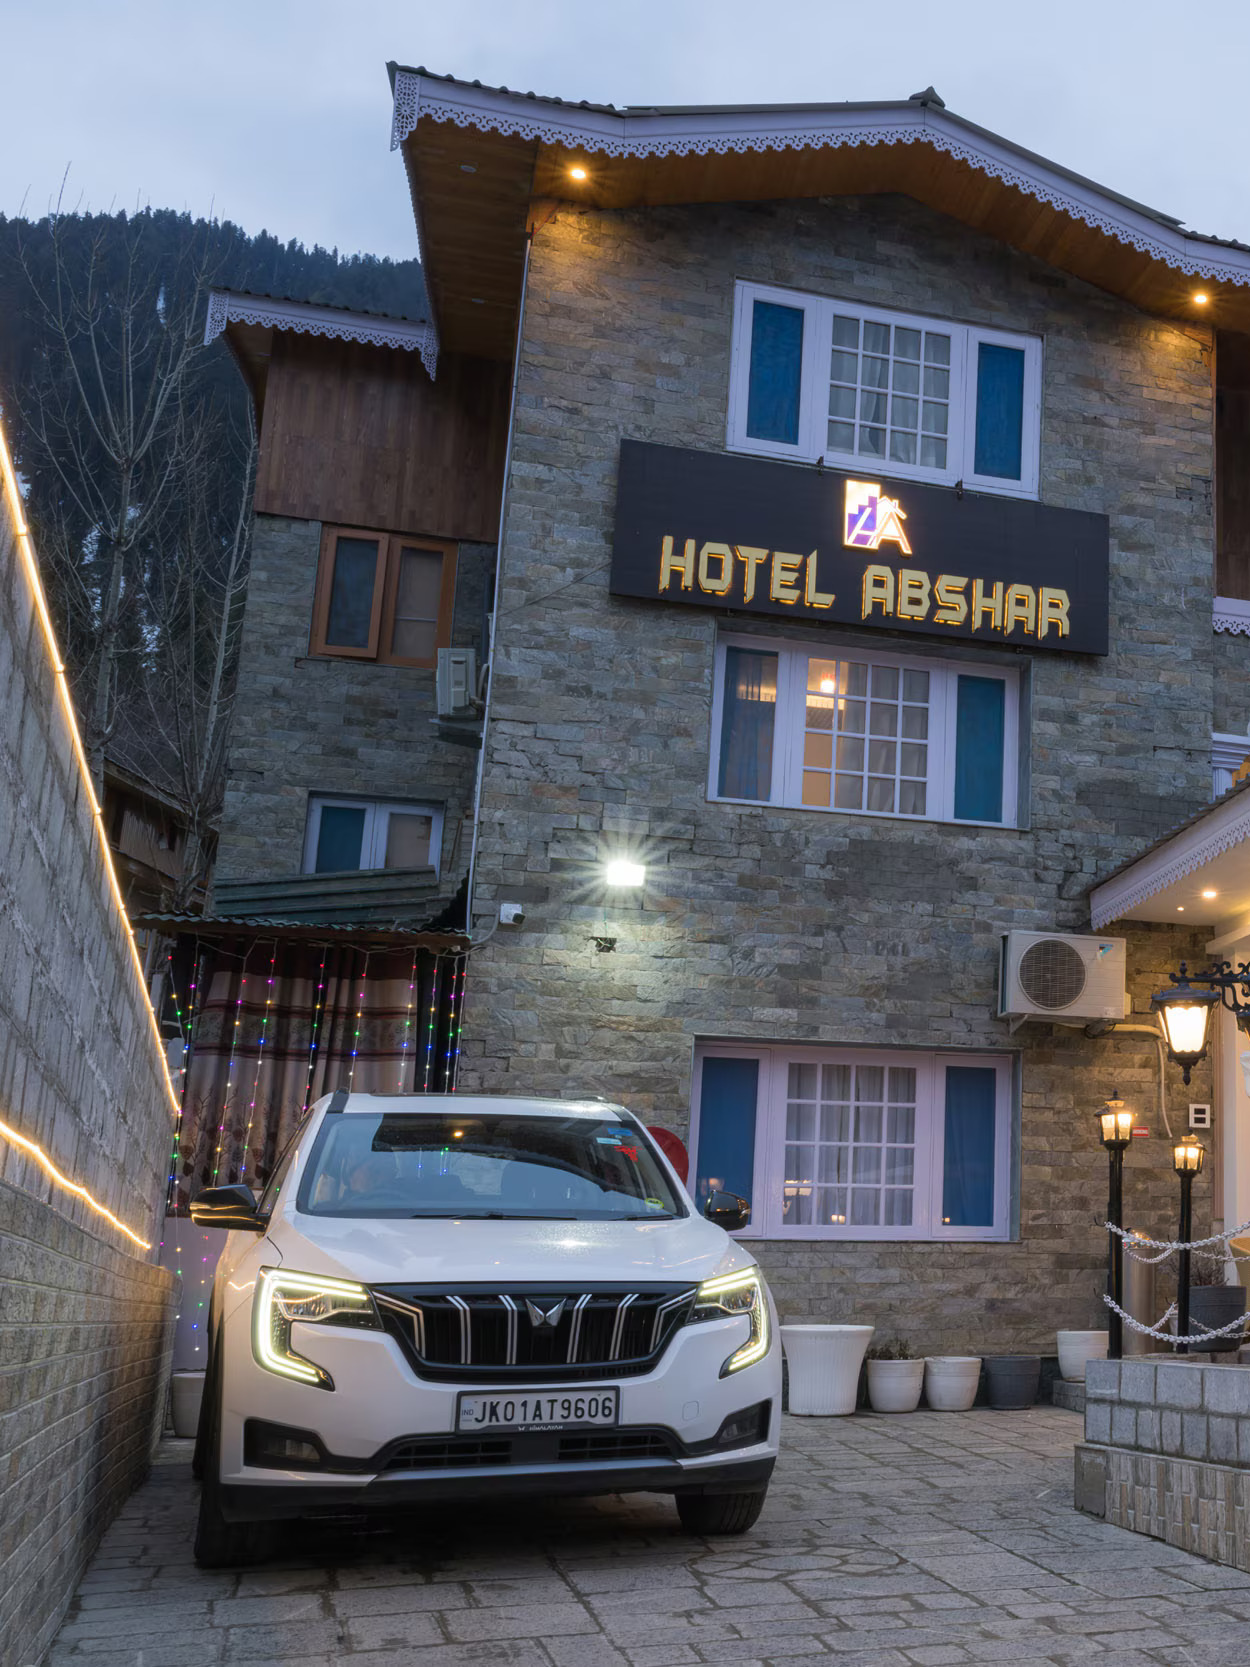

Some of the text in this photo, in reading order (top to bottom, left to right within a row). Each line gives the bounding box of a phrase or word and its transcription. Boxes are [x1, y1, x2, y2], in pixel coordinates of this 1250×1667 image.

[658, 535, 1071, 640] HOTEL ABSHAR
[474, 1396, 613, 1423] JK01AT9606
